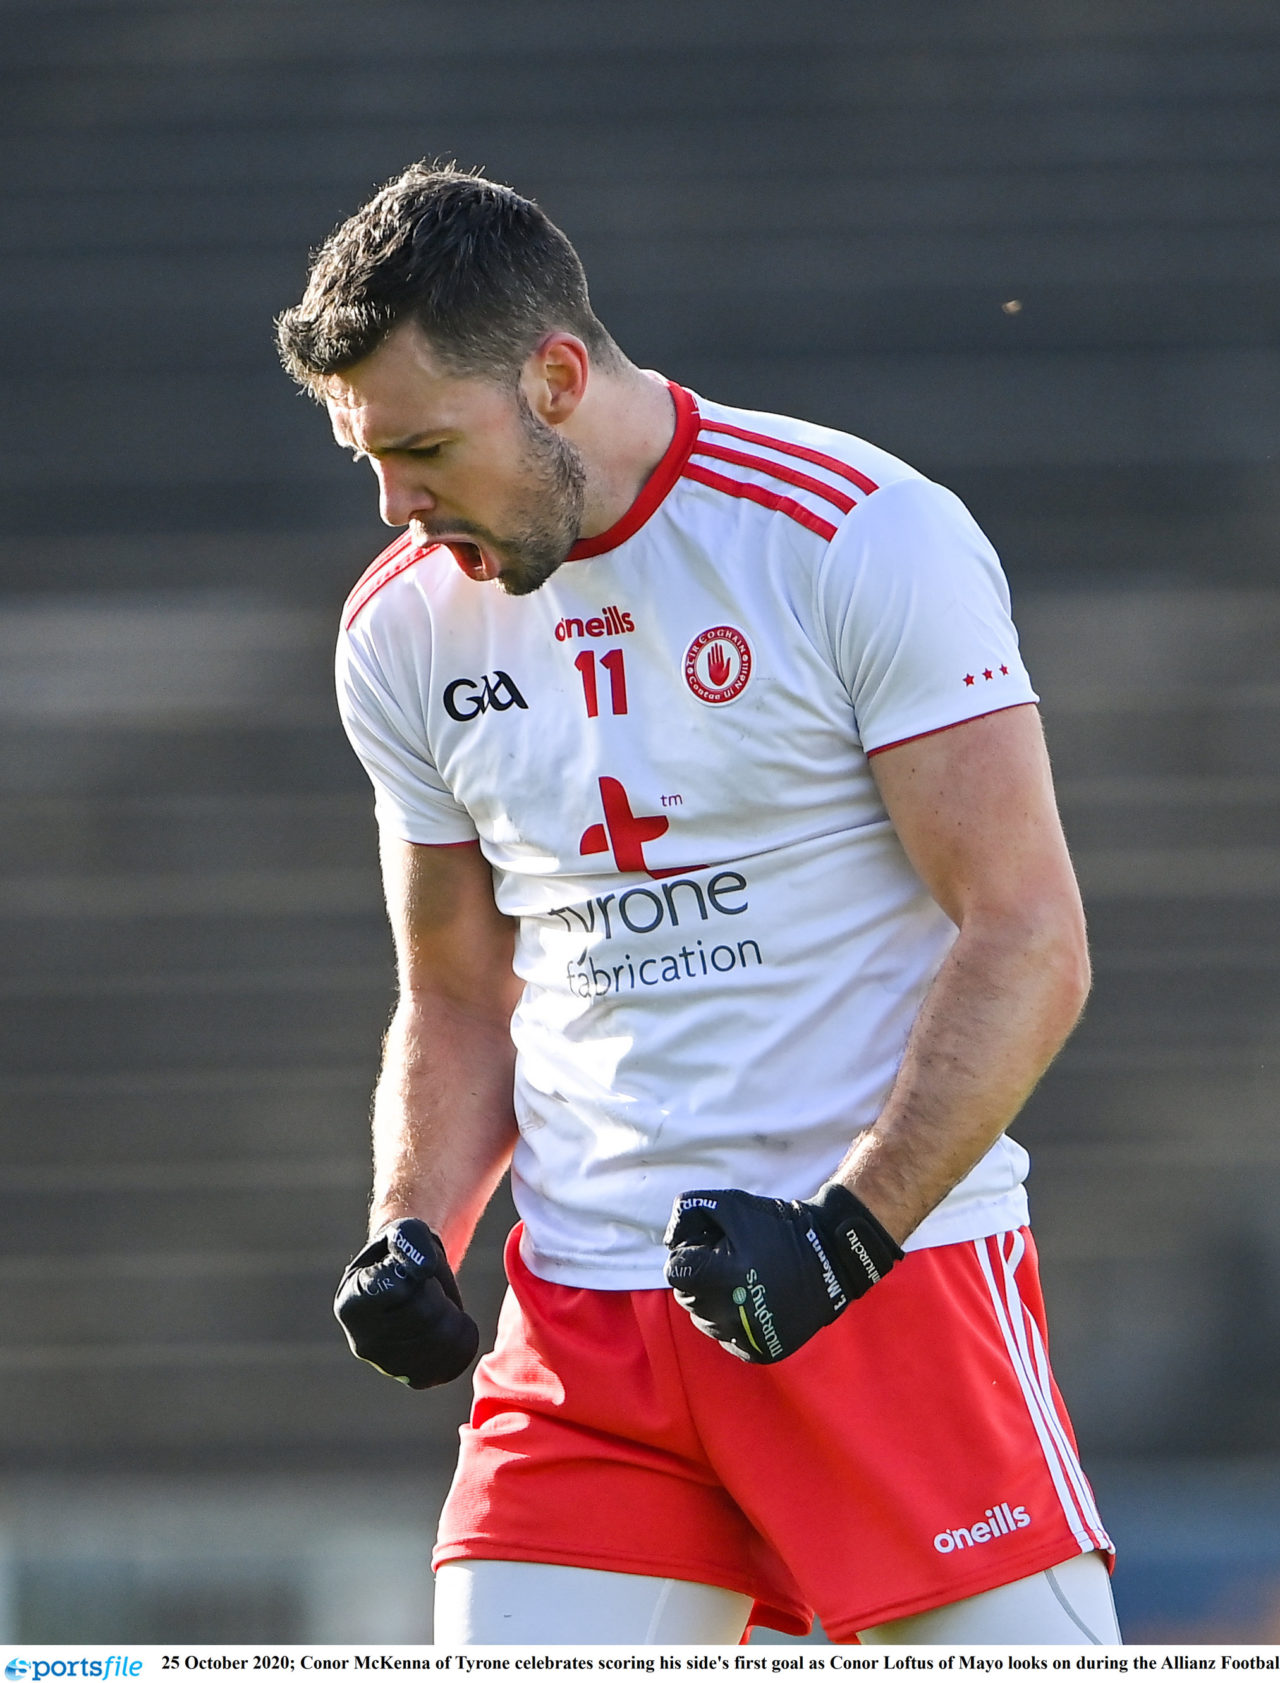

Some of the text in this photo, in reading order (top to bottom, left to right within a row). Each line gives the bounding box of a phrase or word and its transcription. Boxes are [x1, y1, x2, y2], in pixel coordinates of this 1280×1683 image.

[574, 649, 628, 718] 11
[567, 939, 763, 998] fabrication
[805, 1227, 842, 1299] McKenna
